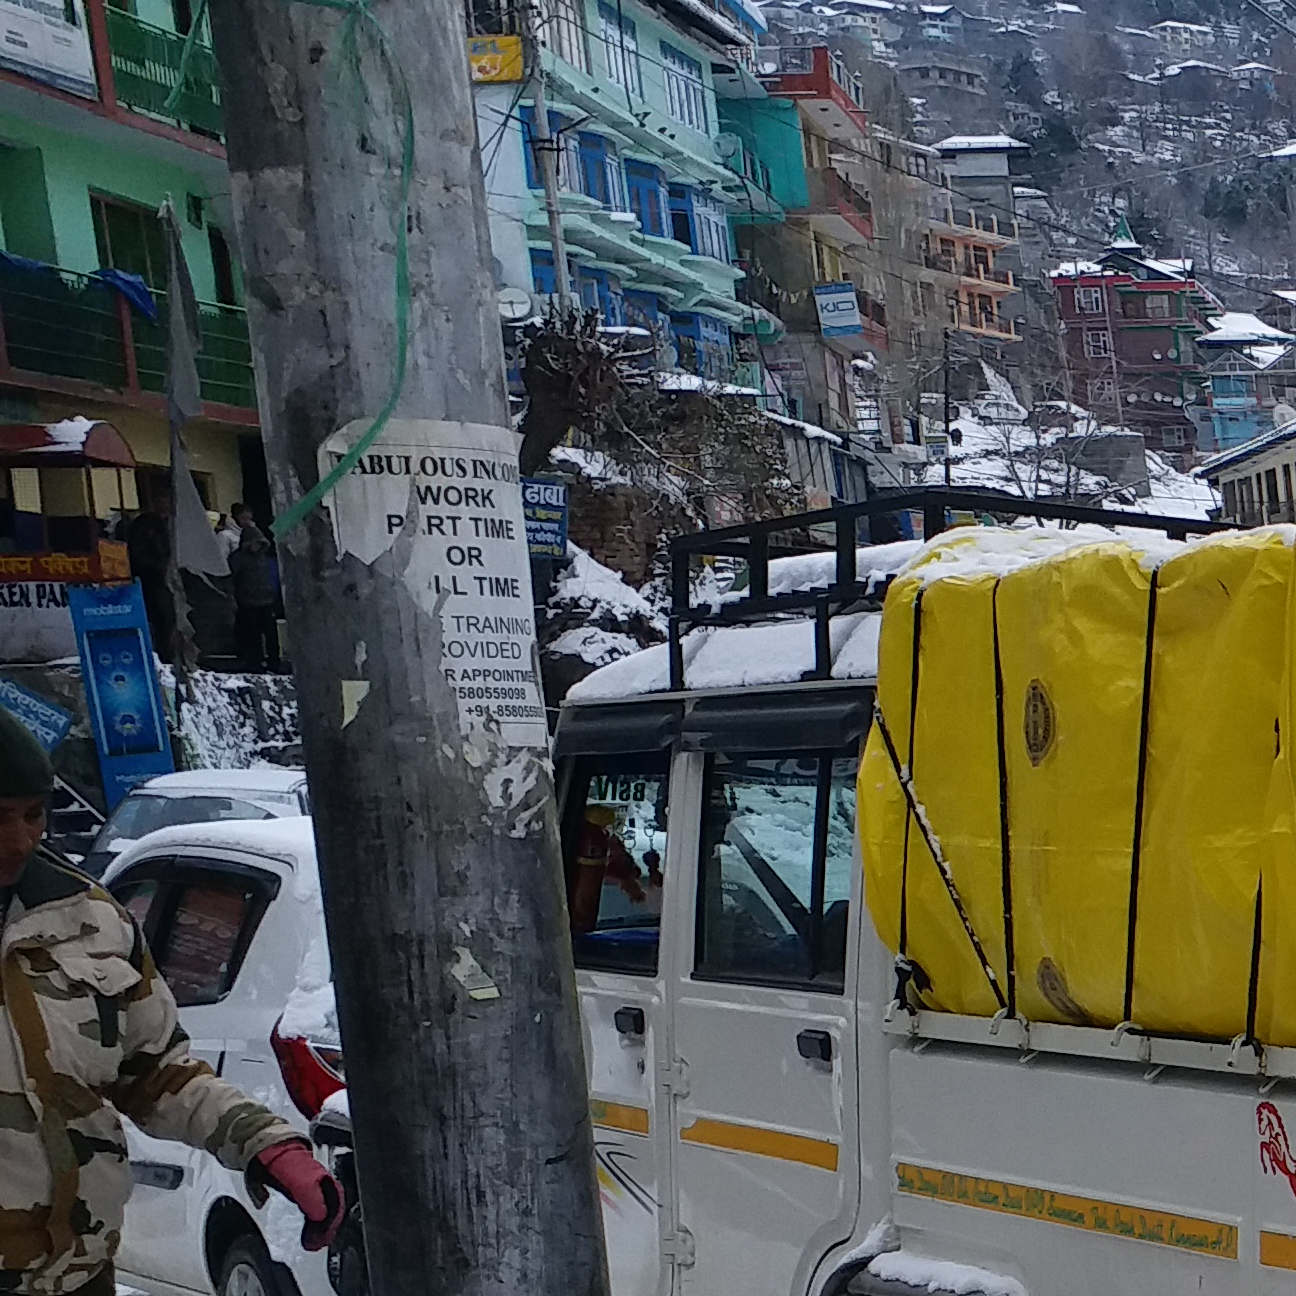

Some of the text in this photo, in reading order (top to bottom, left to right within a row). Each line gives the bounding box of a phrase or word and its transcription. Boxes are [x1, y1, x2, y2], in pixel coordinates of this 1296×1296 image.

[417, 485, 496, 509] WORK
[387, 514, 462, 537] PRT
[469, 517, 515, 540] TIME
[446, 546, 484, 567] OR
[474, 576, 520, 599] TIME
[451, 615, 531, 636] TRAINING
